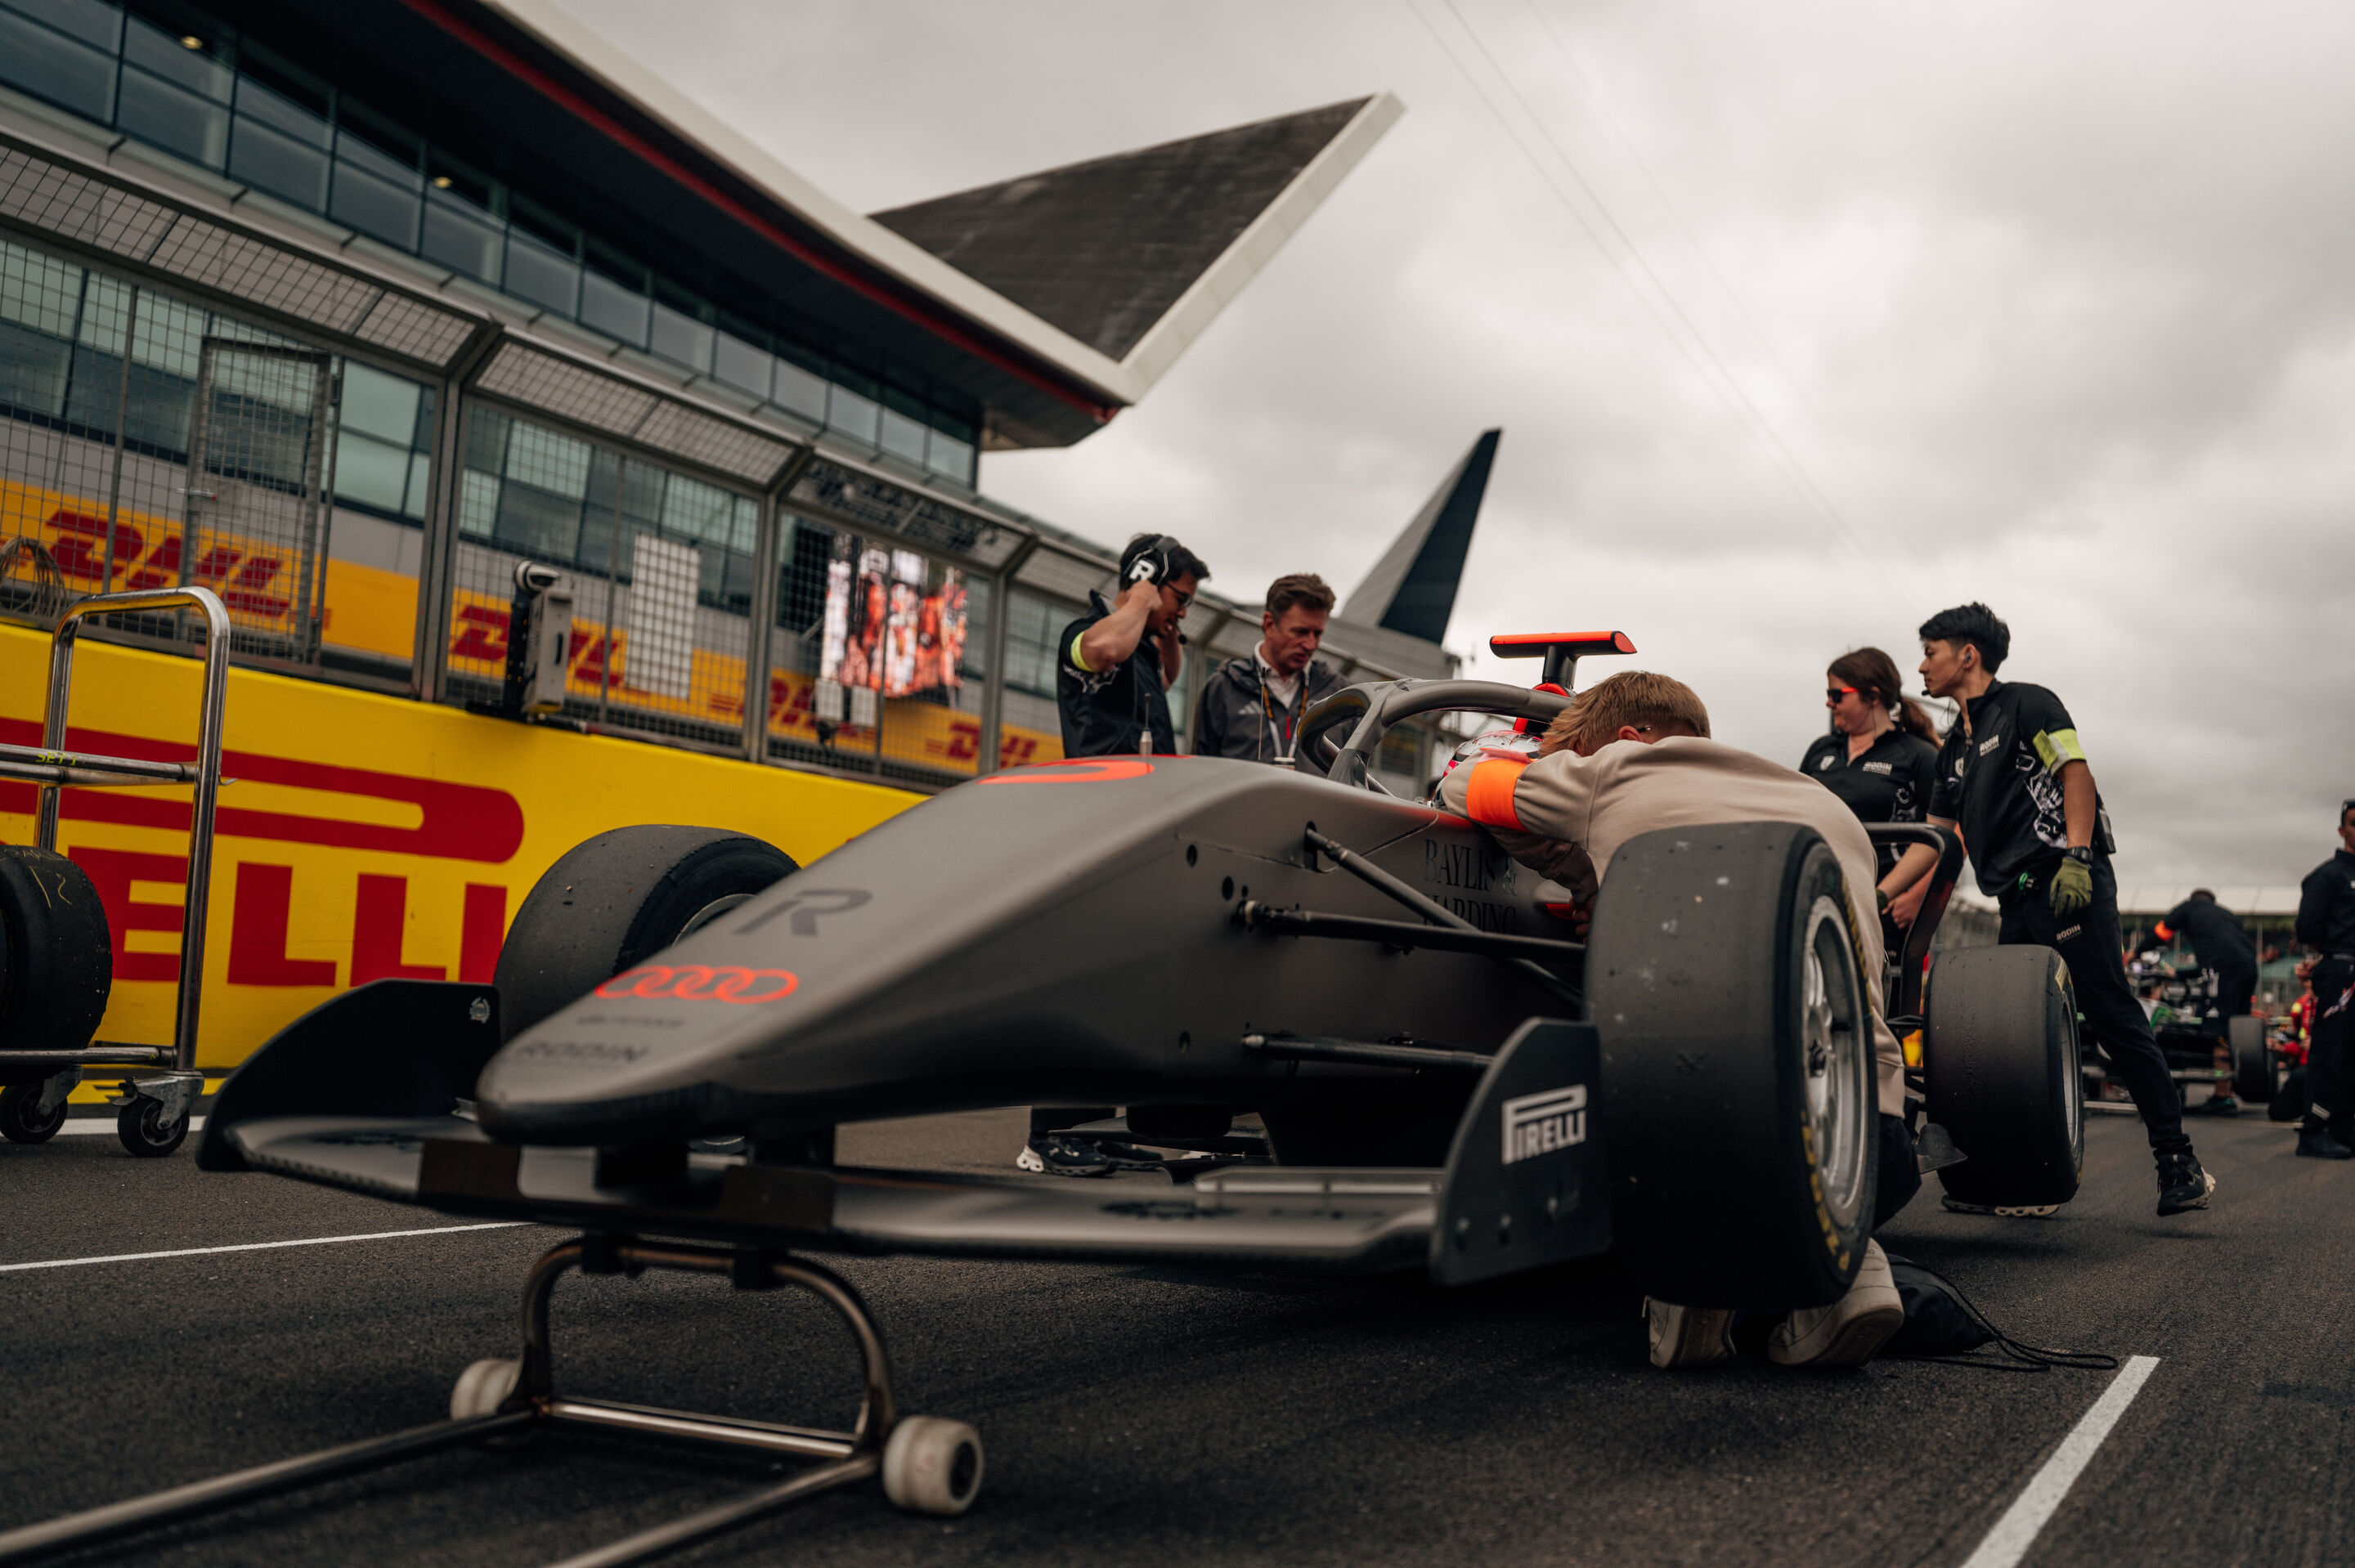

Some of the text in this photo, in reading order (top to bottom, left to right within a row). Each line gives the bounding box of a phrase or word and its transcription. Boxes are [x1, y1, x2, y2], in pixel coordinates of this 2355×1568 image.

[46, 509, 289, 616] DHL
[1129, 559, 1156, 580] R
[36, 752, 65, 764] SET
[1424, 839, 1496, 891] BAYLIS
[733, 888, 872, 936] R
[2056, 924, 2081, 941] RODIN
[1501, 1083, 1587, 1165] PIRELLI
